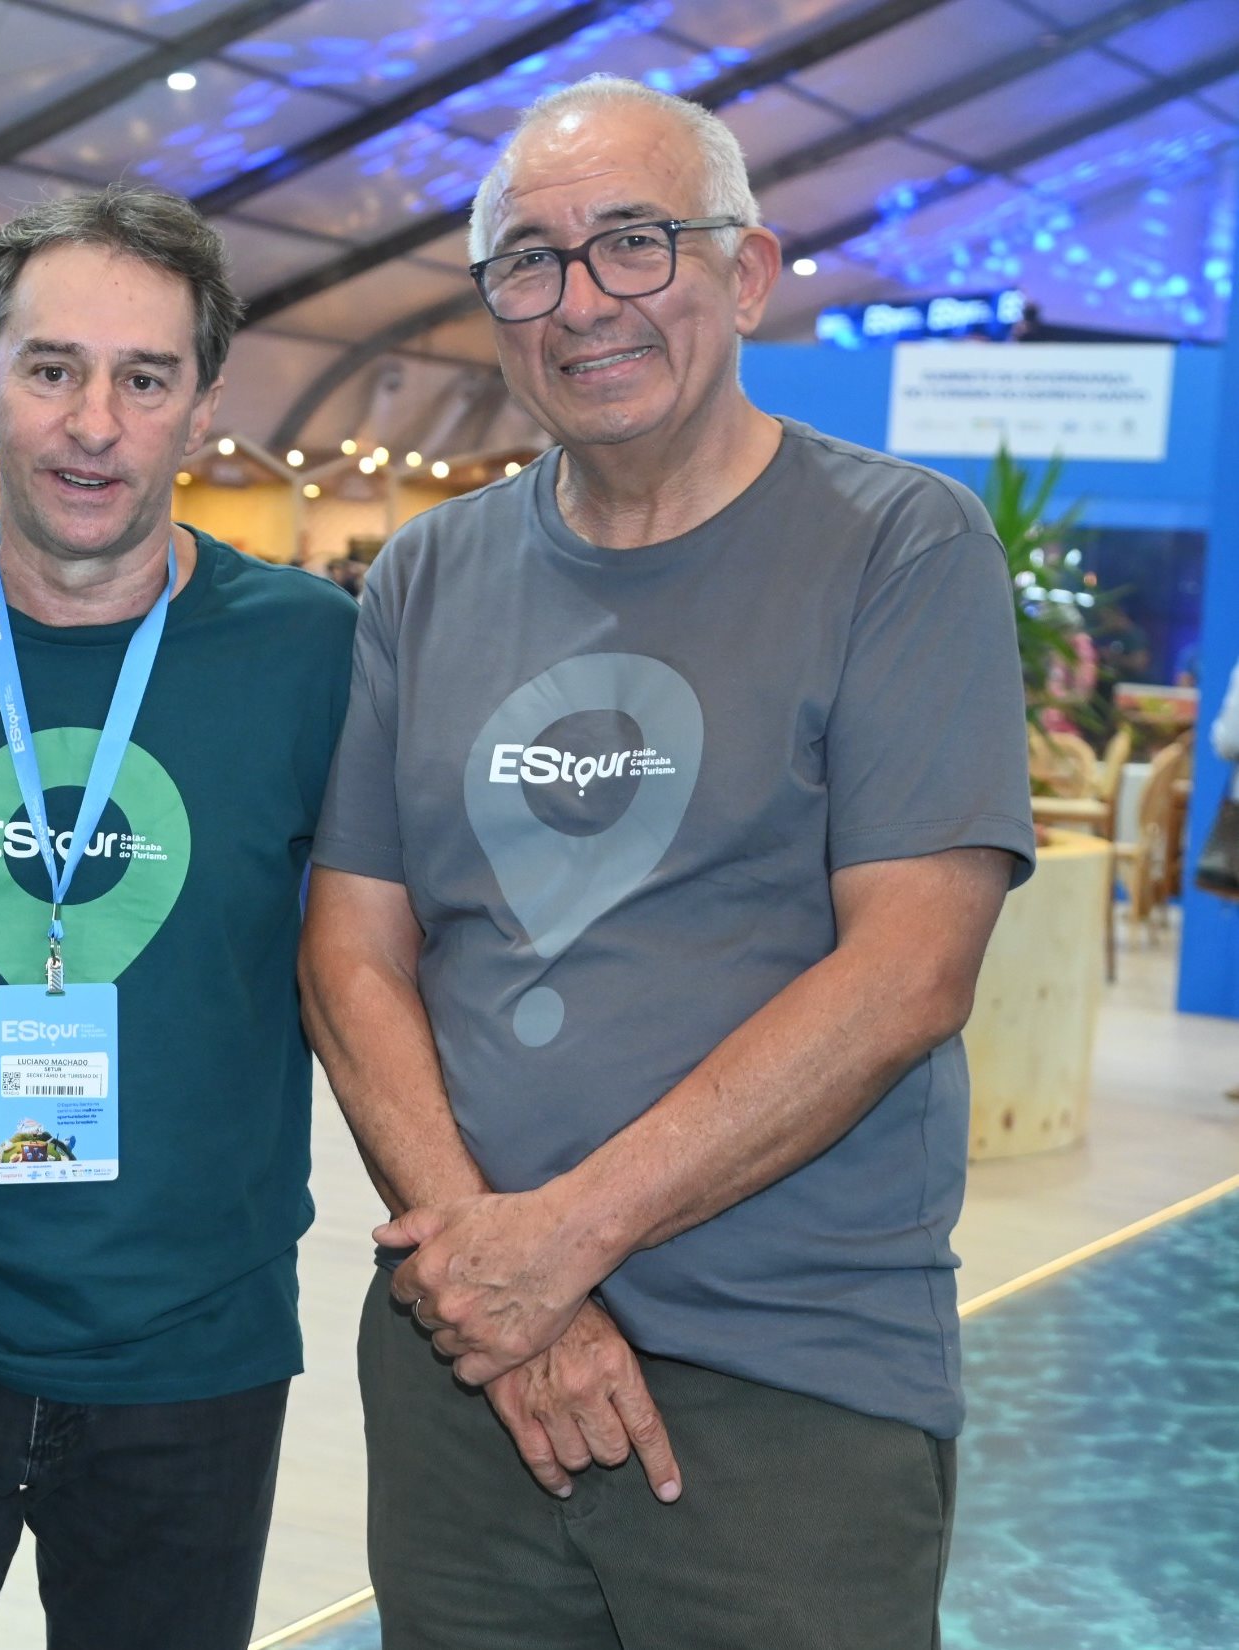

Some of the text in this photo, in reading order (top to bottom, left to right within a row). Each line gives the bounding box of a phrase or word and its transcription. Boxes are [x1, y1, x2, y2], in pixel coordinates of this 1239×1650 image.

[6, 703, 25, 753] EStour
[632, 748, 656, 757] Salão
[630, 757, 671, 767] Capixaba
[489, 743, 631, 792] EStour
[629, 766, 676, 776] do Turismo
[120, 833, 146, 842] Salão
[119, 842, 162, 852] Capixaba
[119, 850, 168, 861] do Turismo
[1, 1020, 80, 1044] EStour
[51, 1059, 88, 1067] MACHADO
